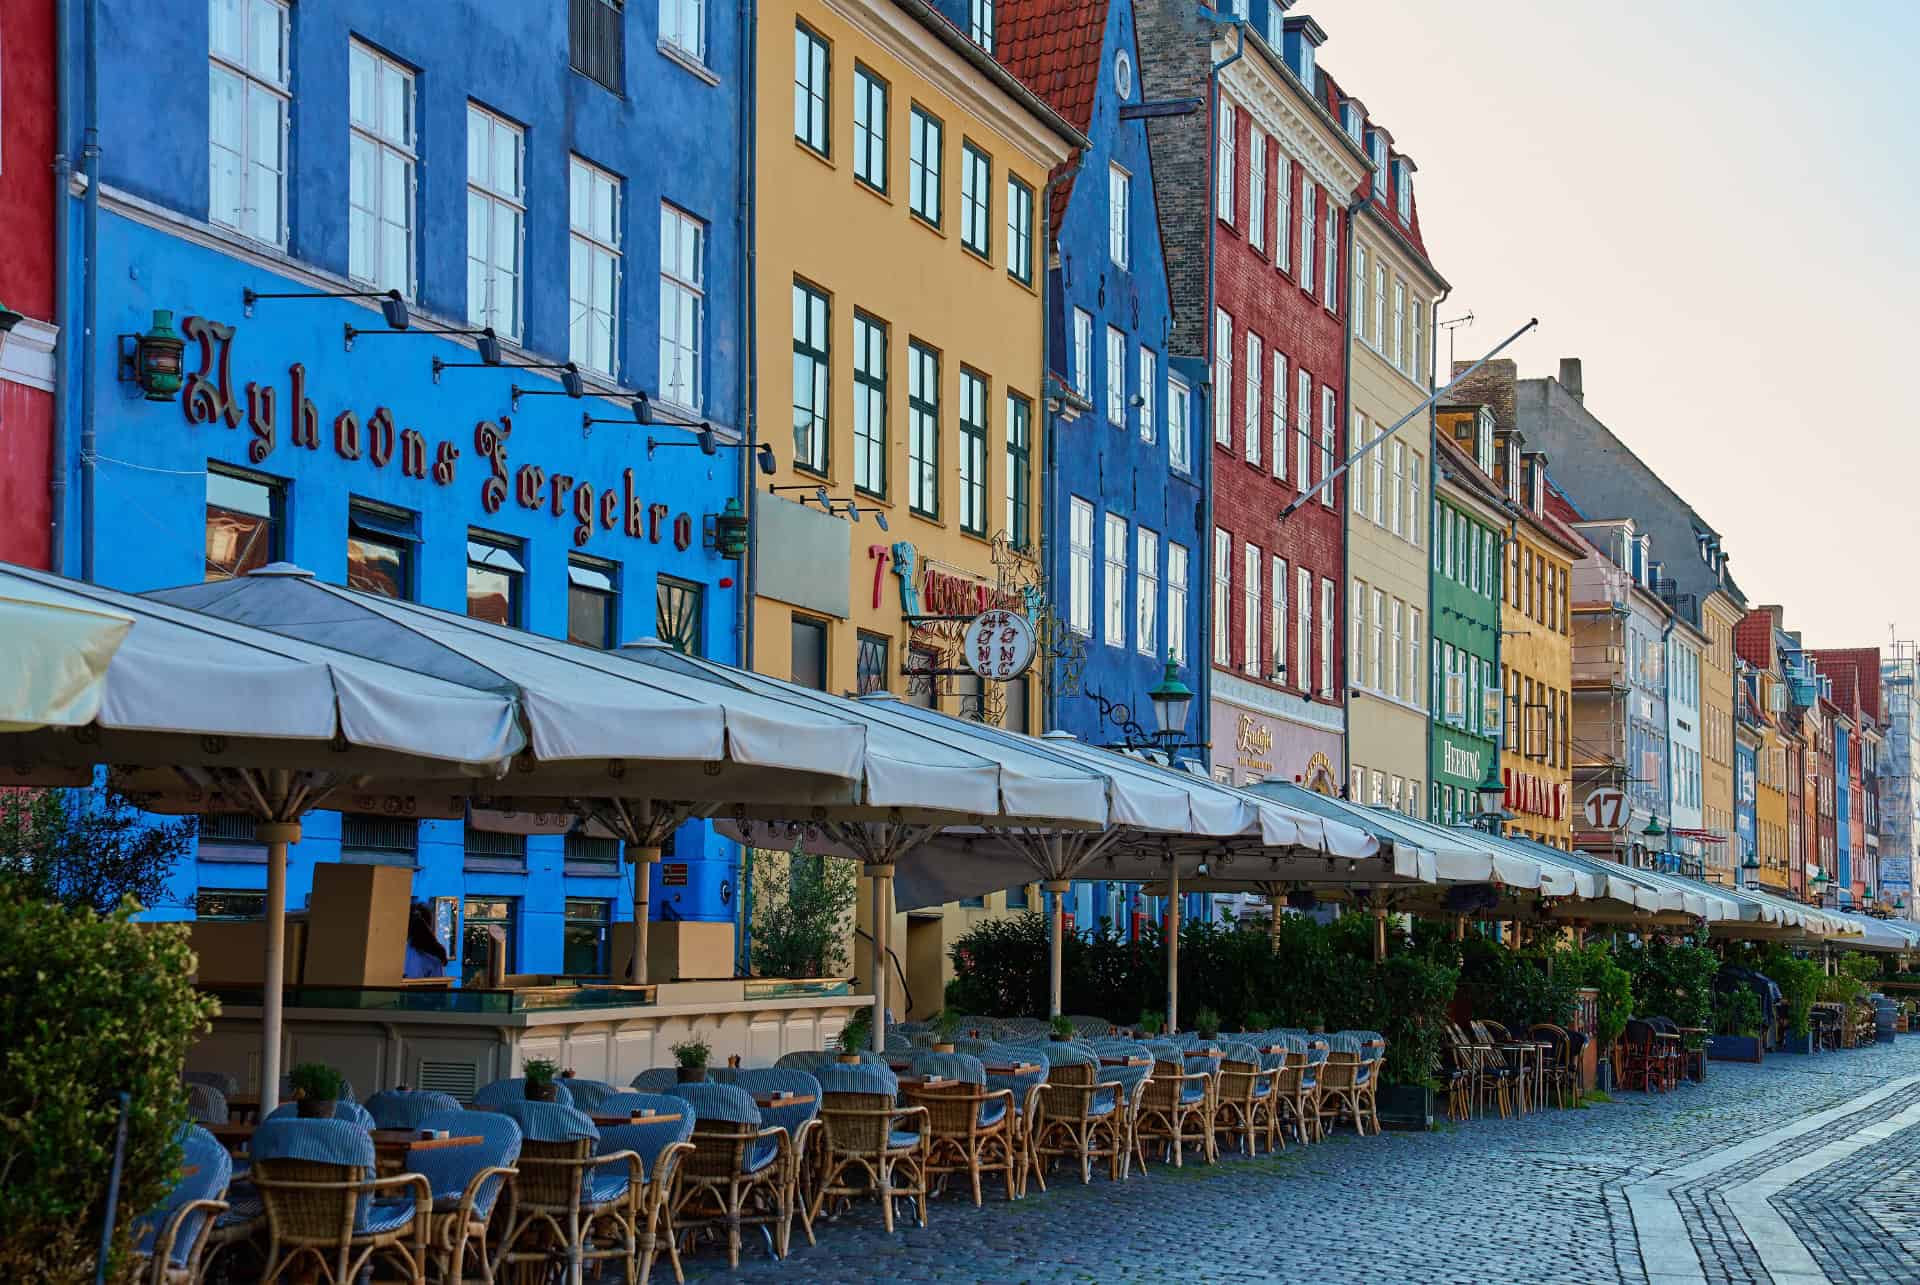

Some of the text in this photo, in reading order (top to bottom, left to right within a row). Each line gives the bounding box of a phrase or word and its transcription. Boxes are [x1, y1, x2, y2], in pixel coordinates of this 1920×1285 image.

[474, 415, 692, 552] Færgekro
[1443, 740, 1481, 781] HEERING
[1587, 793, 1624, 828] 17
